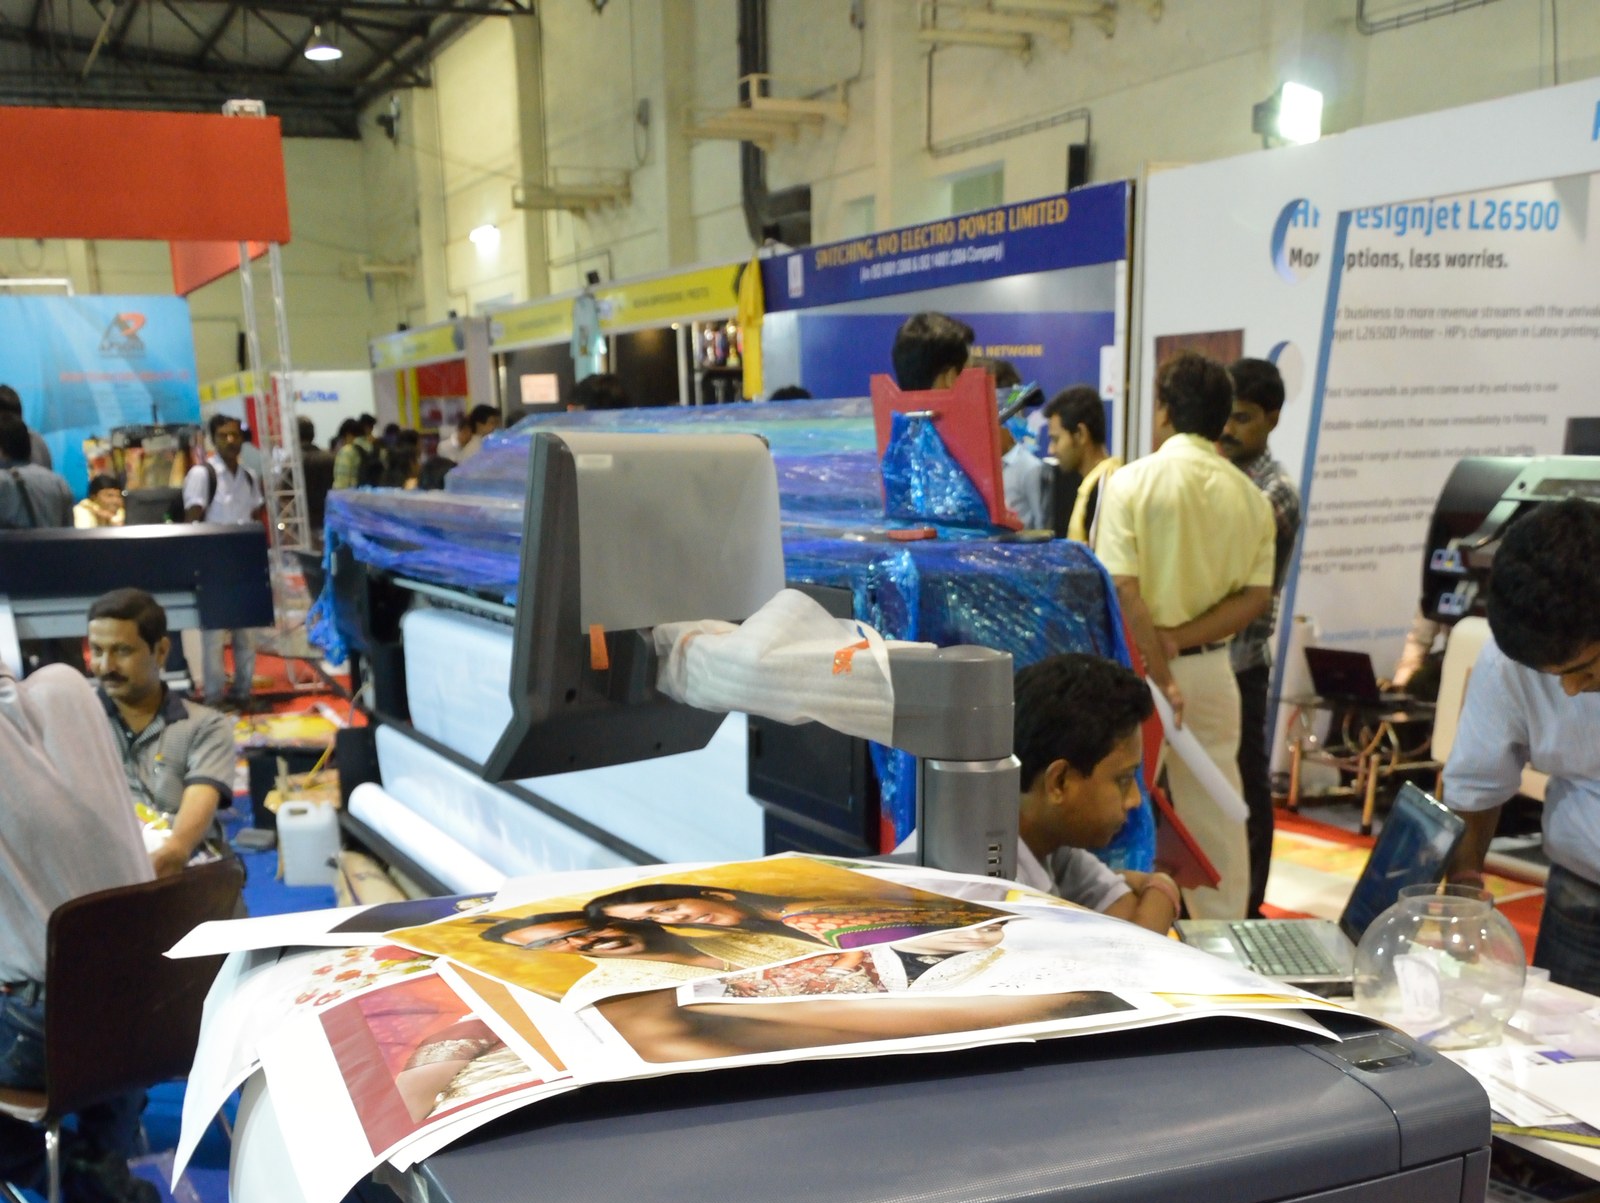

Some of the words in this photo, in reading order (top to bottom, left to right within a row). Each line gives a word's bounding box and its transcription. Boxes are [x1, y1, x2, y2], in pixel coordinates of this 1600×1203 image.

[901, 220, 956, 253] ELECTRO
[958, 209, 1006, 241] POWER
[1008, 197, 1069, 232] LIMITED
[1349, 198, 1460, 236] esignjet
[1467, 199, 1561, 231] L26500
[1409, 247, 1441, 268] less
